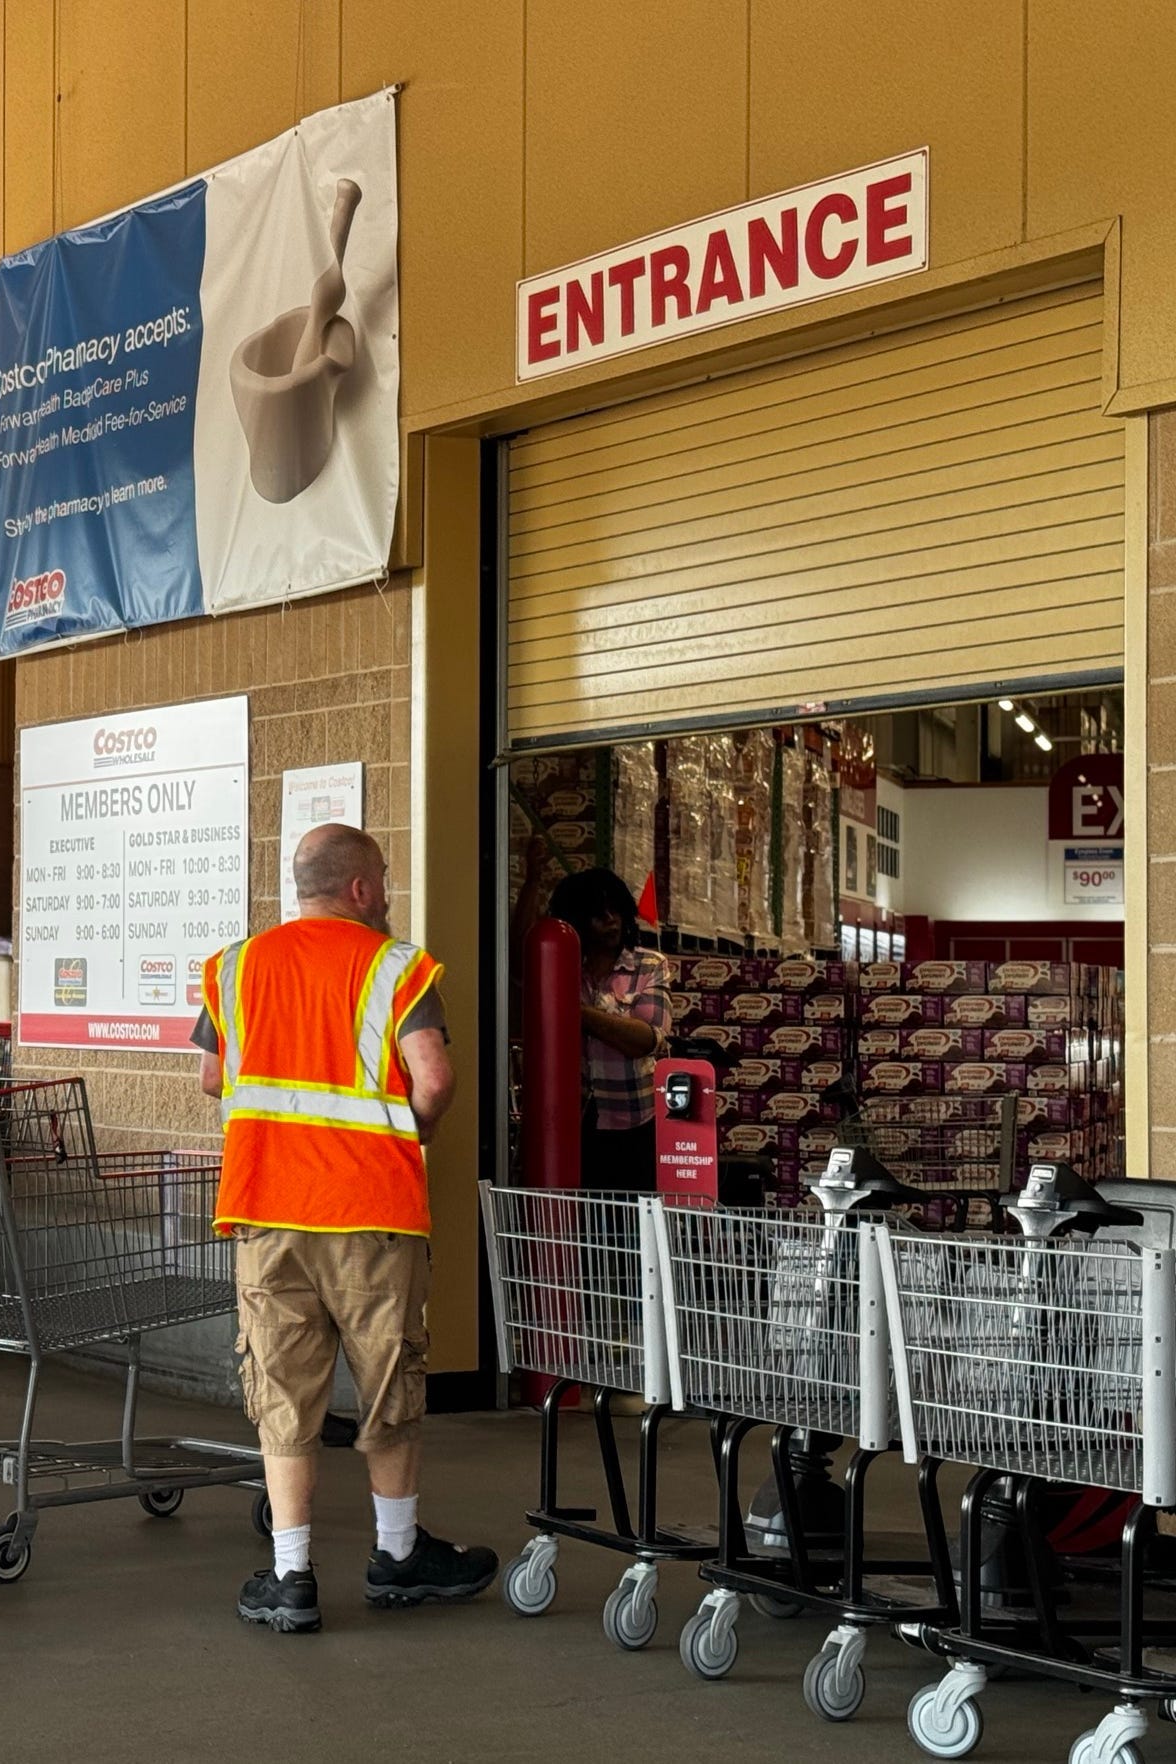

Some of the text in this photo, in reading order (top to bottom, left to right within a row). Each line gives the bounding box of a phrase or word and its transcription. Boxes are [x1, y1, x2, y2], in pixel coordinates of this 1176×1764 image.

[528, 172, 912, 365] ENTRANCE
[125, 307, 191, 352] accepts:
[125, 369, 149, 391] Plus
[105, 396, 187, 434] Fee-for-Service
[48, 495, 104, 525] pharmacy
[111, 484, 135, 505] learn
[137, 474, 167, 496] more.
[93, 727, 158, 755] COSTCO
[112, 751, 156, 766] WHOLESALE
[60, 780, 196, 822] MEMBERS ONLY
[49, 837, 95, 854] EXECUTIVE
[129, 825, 241, 848] GOLD STAR & BUSINESS
[26, 868, 46, 883] MON
[52, 866, 66, 881] FRI
[76, 864, 95, 880] 9:00
[101, 863, 121, 880] 8:30
[128, 861, 152, 877] MON
[160, 859, 175, 876] FRI
[182, 857, 210, 875] 10:00
[218, 855, 241, 873] 8:30
[26, 895, 70, 913] SATURDAY
[76, 894, 95, 911] 9:00
[101, 893, 121, 910] 7:00
[128, 890, 180, 908] SATURDAY
[187, 889, 210, 906] 9:30
[218, 888, 240, 905] 7:00
[25, 925, 60, 942] SUNDAY
[75, 924, 95, 941] 9:00
[101, 924, 121, 940] 6:00
[128, 922, 168, 940] SUNDAY
[182, 921, 210, 939] 10:00
[218, 920, 240, 938] 6:00
[140, 960, 174, 973] COSTCO
[88, 1022, 160, 1041] WWW.COSTCO.COM
[675, 1142, 697, 1151] SCAN
[660, 1154, 713, 1166] MEMBERSHIP
[676, 1169, 697, 1179] HERE
